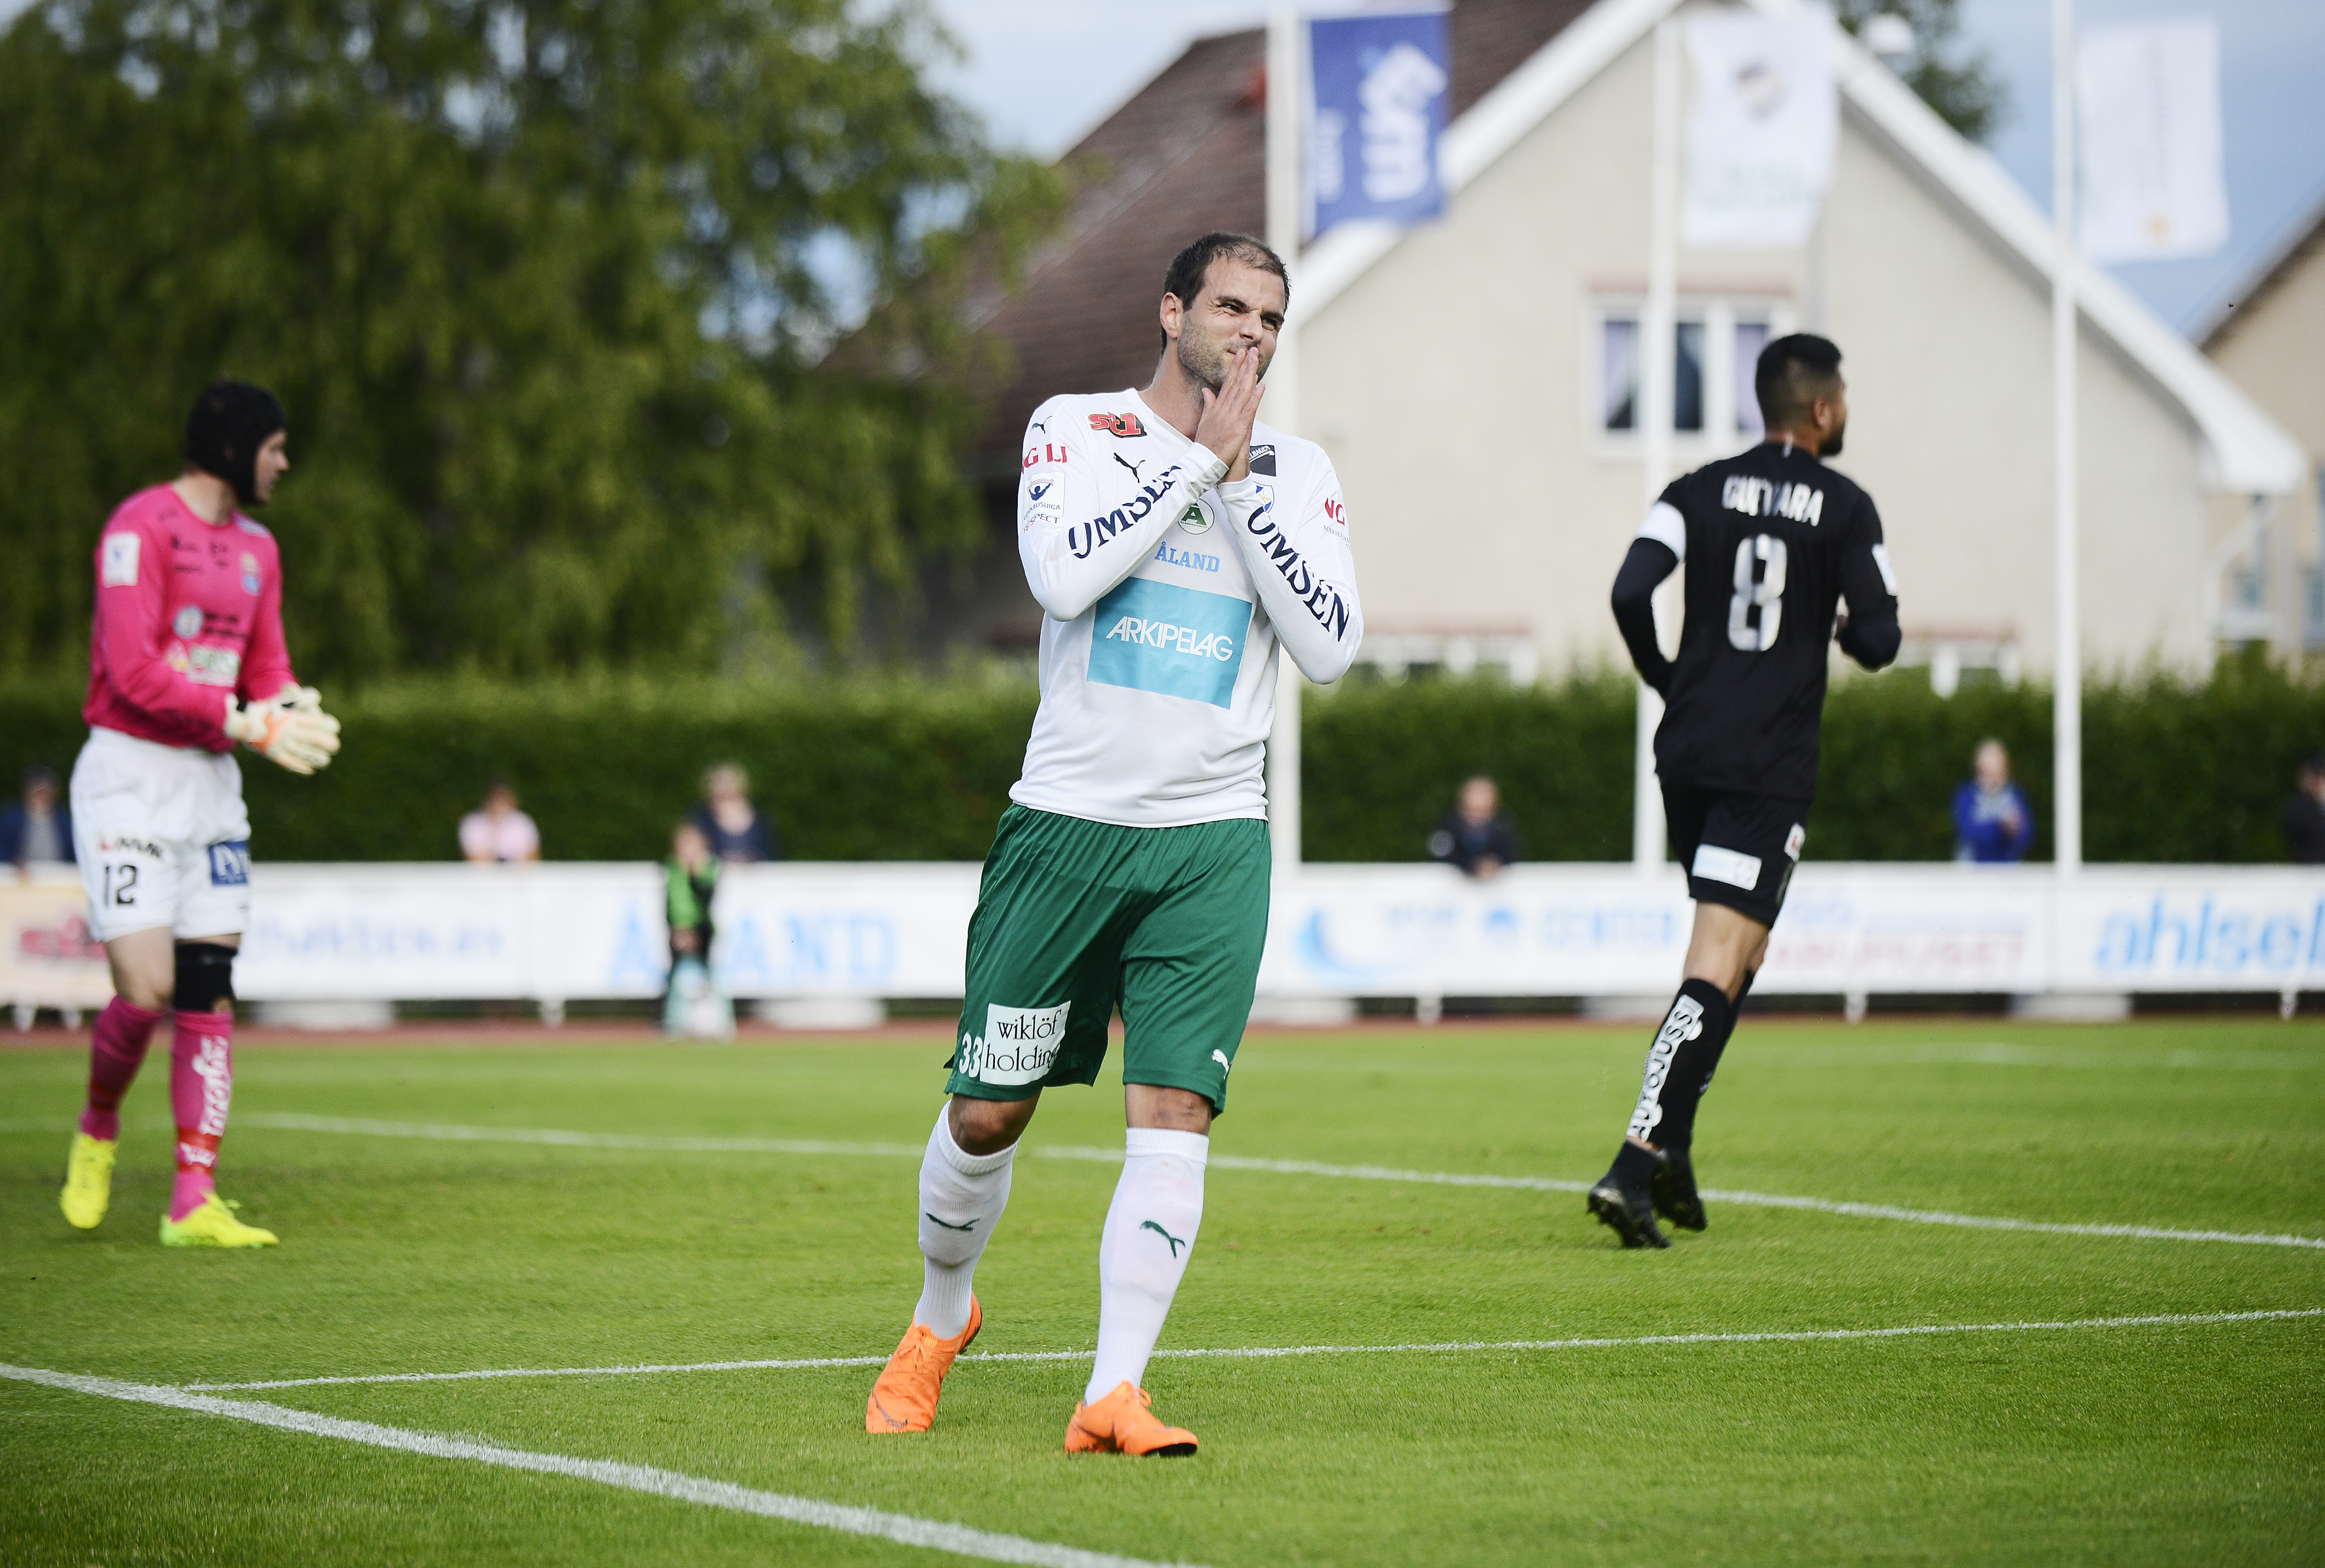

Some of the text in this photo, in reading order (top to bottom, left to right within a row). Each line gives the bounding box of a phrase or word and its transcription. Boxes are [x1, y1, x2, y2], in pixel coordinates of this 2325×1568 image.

[1155, 541, 1220, 573] ÅLAND
[1728, 533, 1788, 652] 8
[1106, 616, 1233, 662] ARKIPELAG
[105, 864, 138, 907] 12
[997, 1009, 1062, 1039] wiklöf
[959, 1031, 983, 1078] 33
[984, 1042, 1060, 1072] holding
